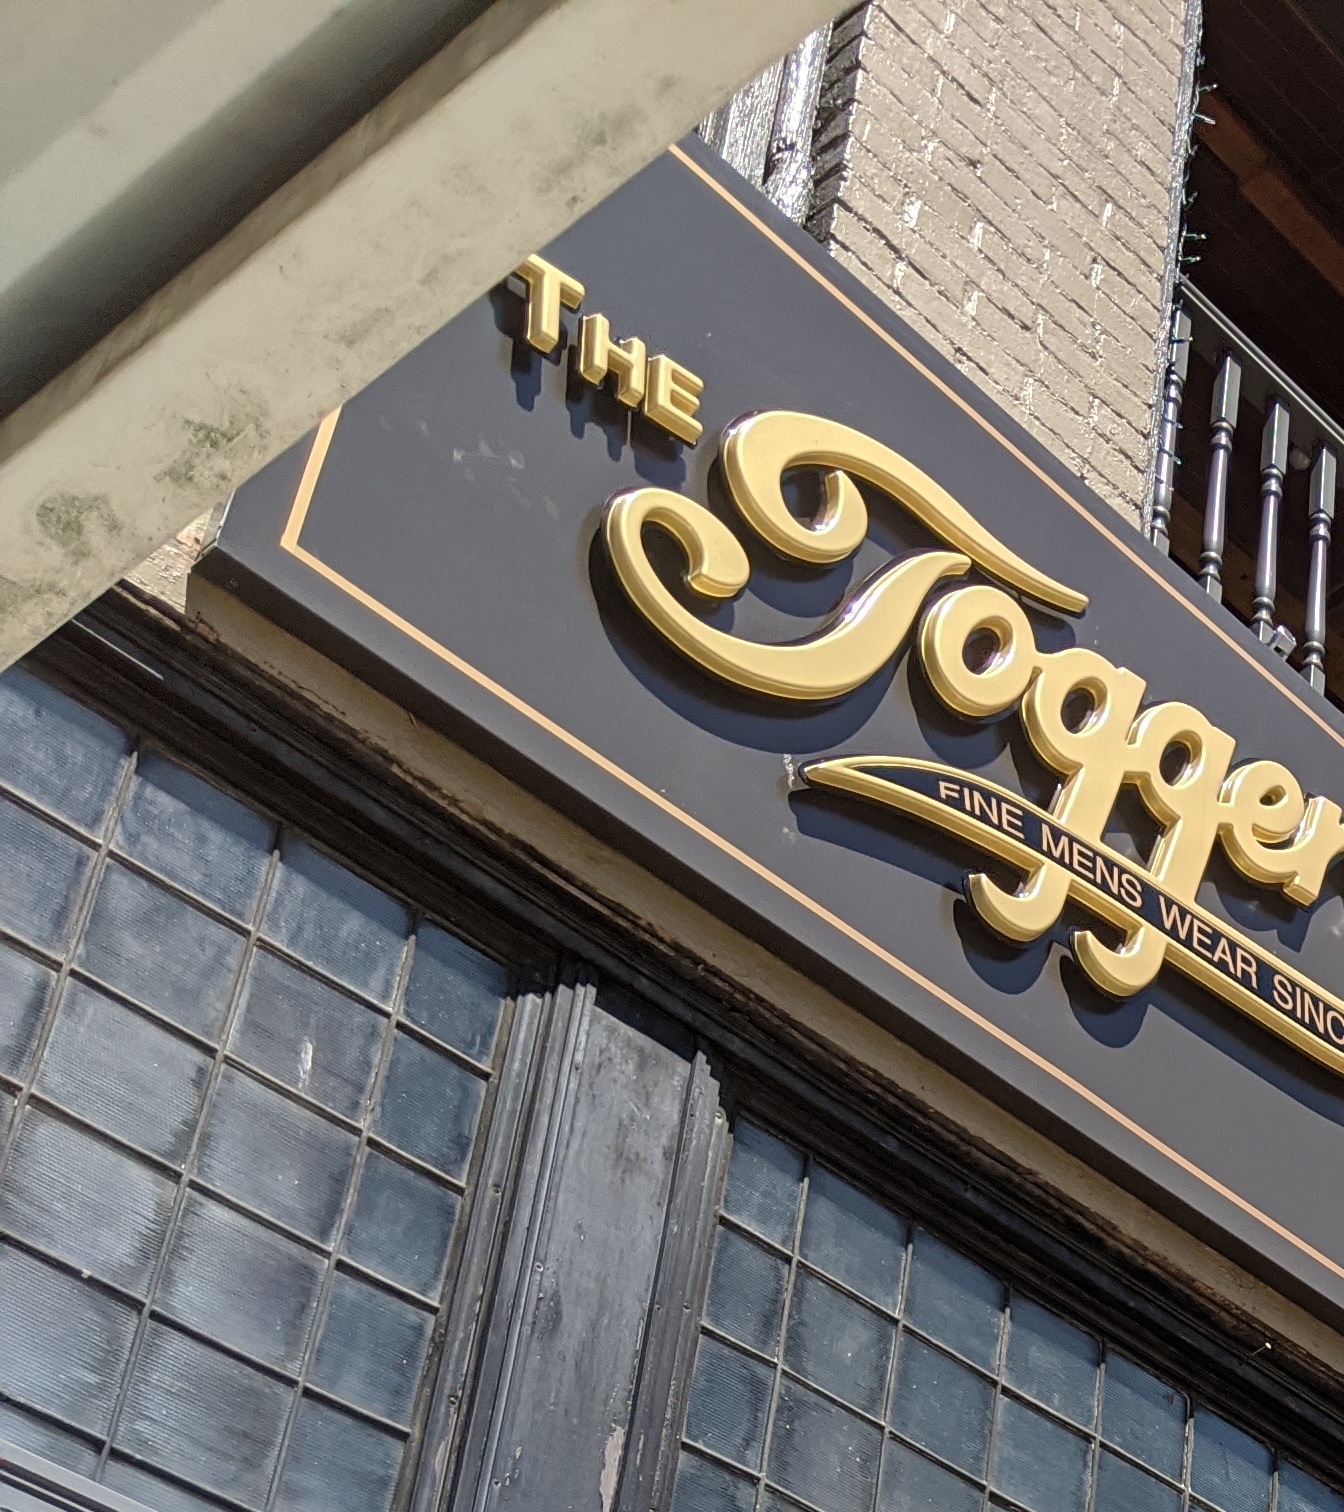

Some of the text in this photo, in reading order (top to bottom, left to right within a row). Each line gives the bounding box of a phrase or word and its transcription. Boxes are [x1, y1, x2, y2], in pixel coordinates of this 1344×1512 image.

[514, 254, 703, 444] THE
[939, 782, 1024, 839] FINE
[1041, 829, 1142, 908] MENS
[1160, 899, 1259, 990] WEAR
